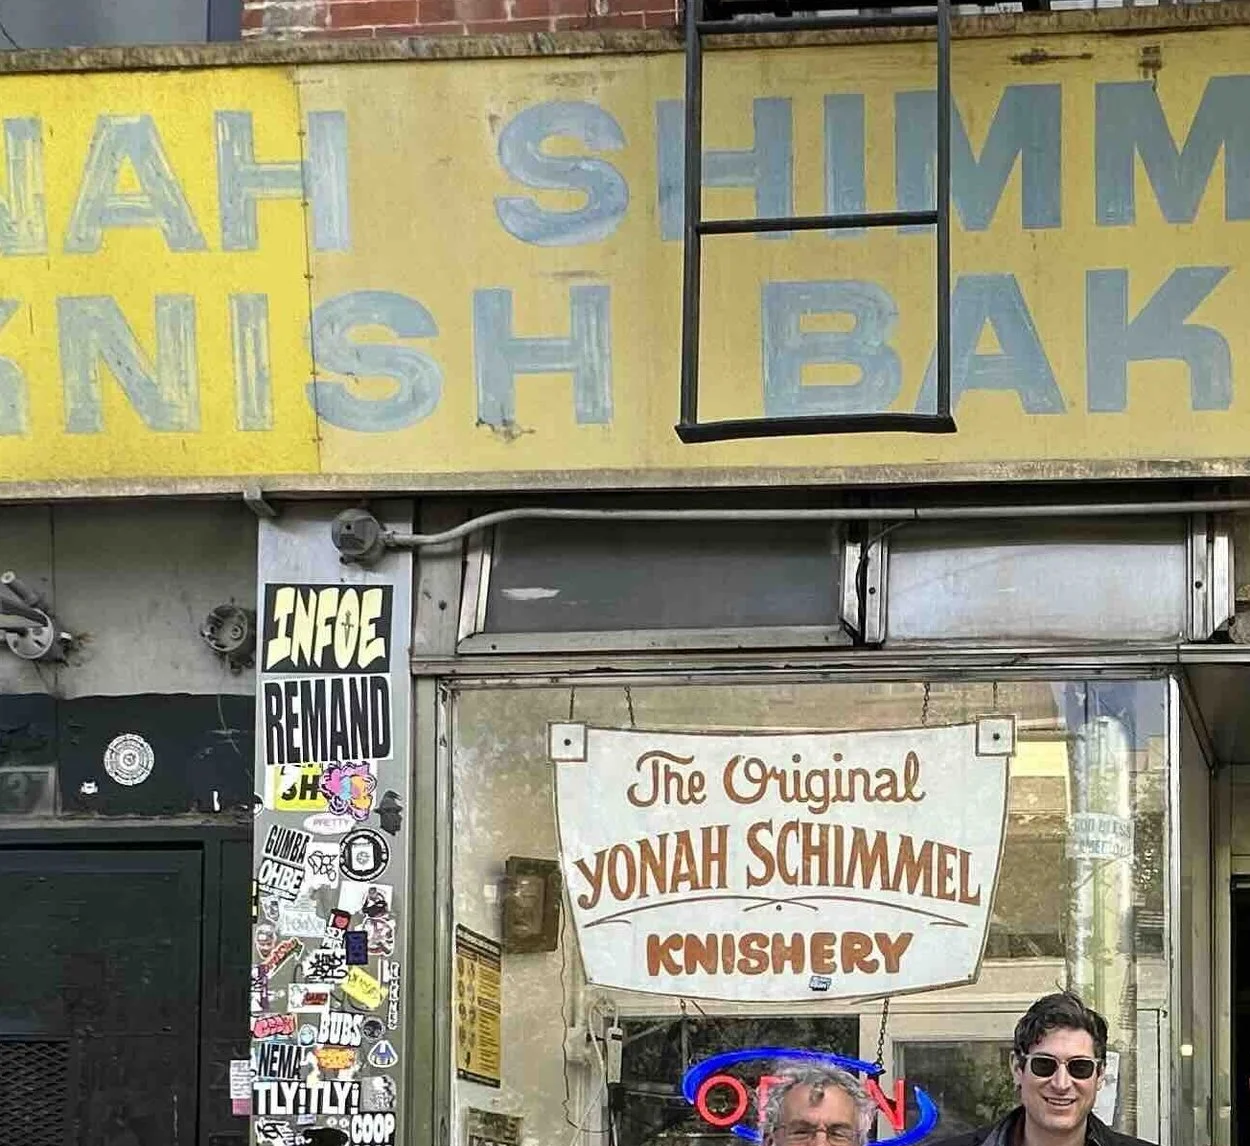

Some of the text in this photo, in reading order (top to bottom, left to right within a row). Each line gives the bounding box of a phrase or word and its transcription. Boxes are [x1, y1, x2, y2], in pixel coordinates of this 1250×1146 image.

[266, 586, 386, 669] INFOE
[264, 676, 391, 765] REMAND
[627, 750, 925, 814] The Original
[572, 818, 982, 910] YONAH SCHIMMEL
[646, 931, 914, 977] KNISHERY
[351, 1113, 396, 1144] COOP
